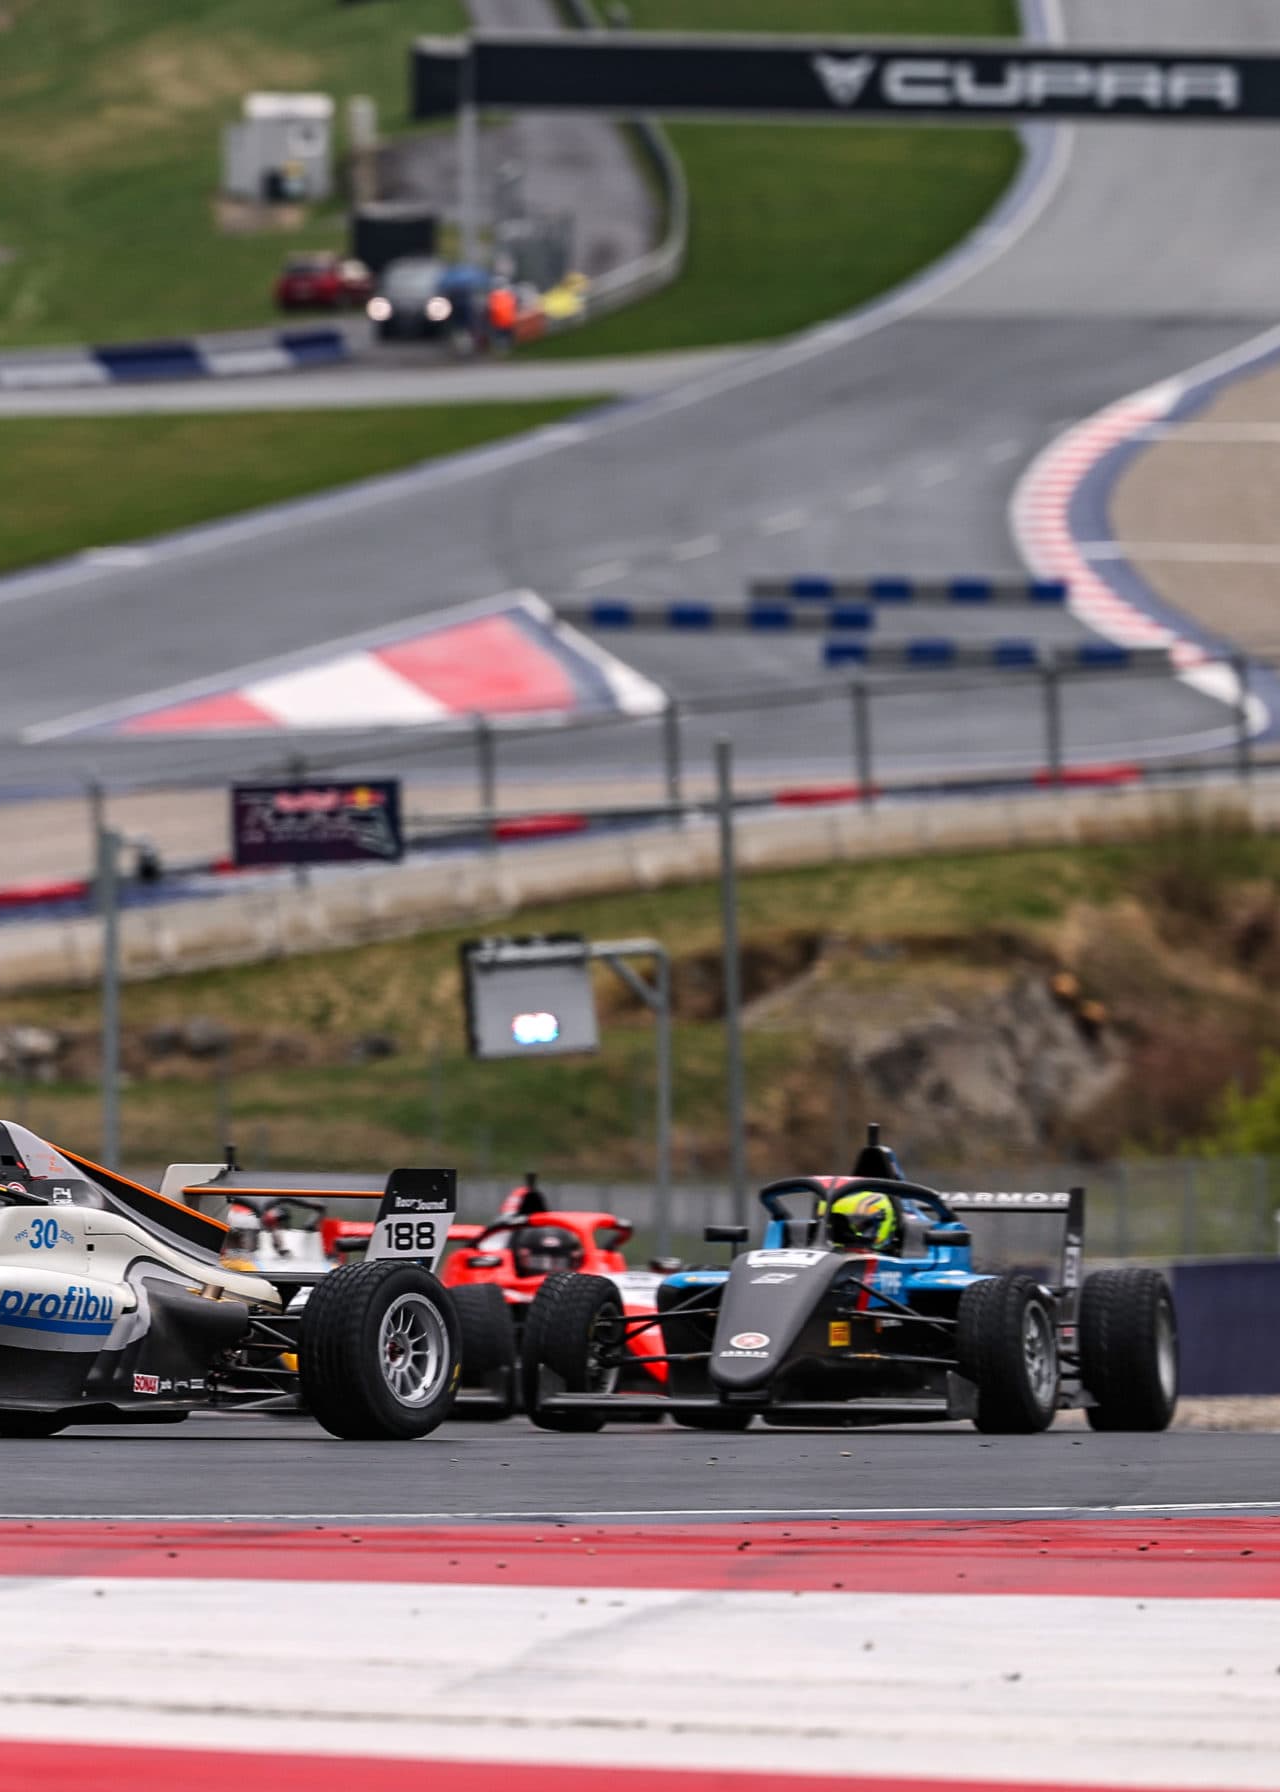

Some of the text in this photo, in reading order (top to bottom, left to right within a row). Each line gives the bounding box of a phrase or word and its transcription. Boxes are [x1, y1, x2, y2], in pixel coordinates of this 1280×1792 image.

[880, 58, 1239, 108] CUPRA
[29, 1218, 58, 1249] 30
[384, 1221, 435, 1251] 188
